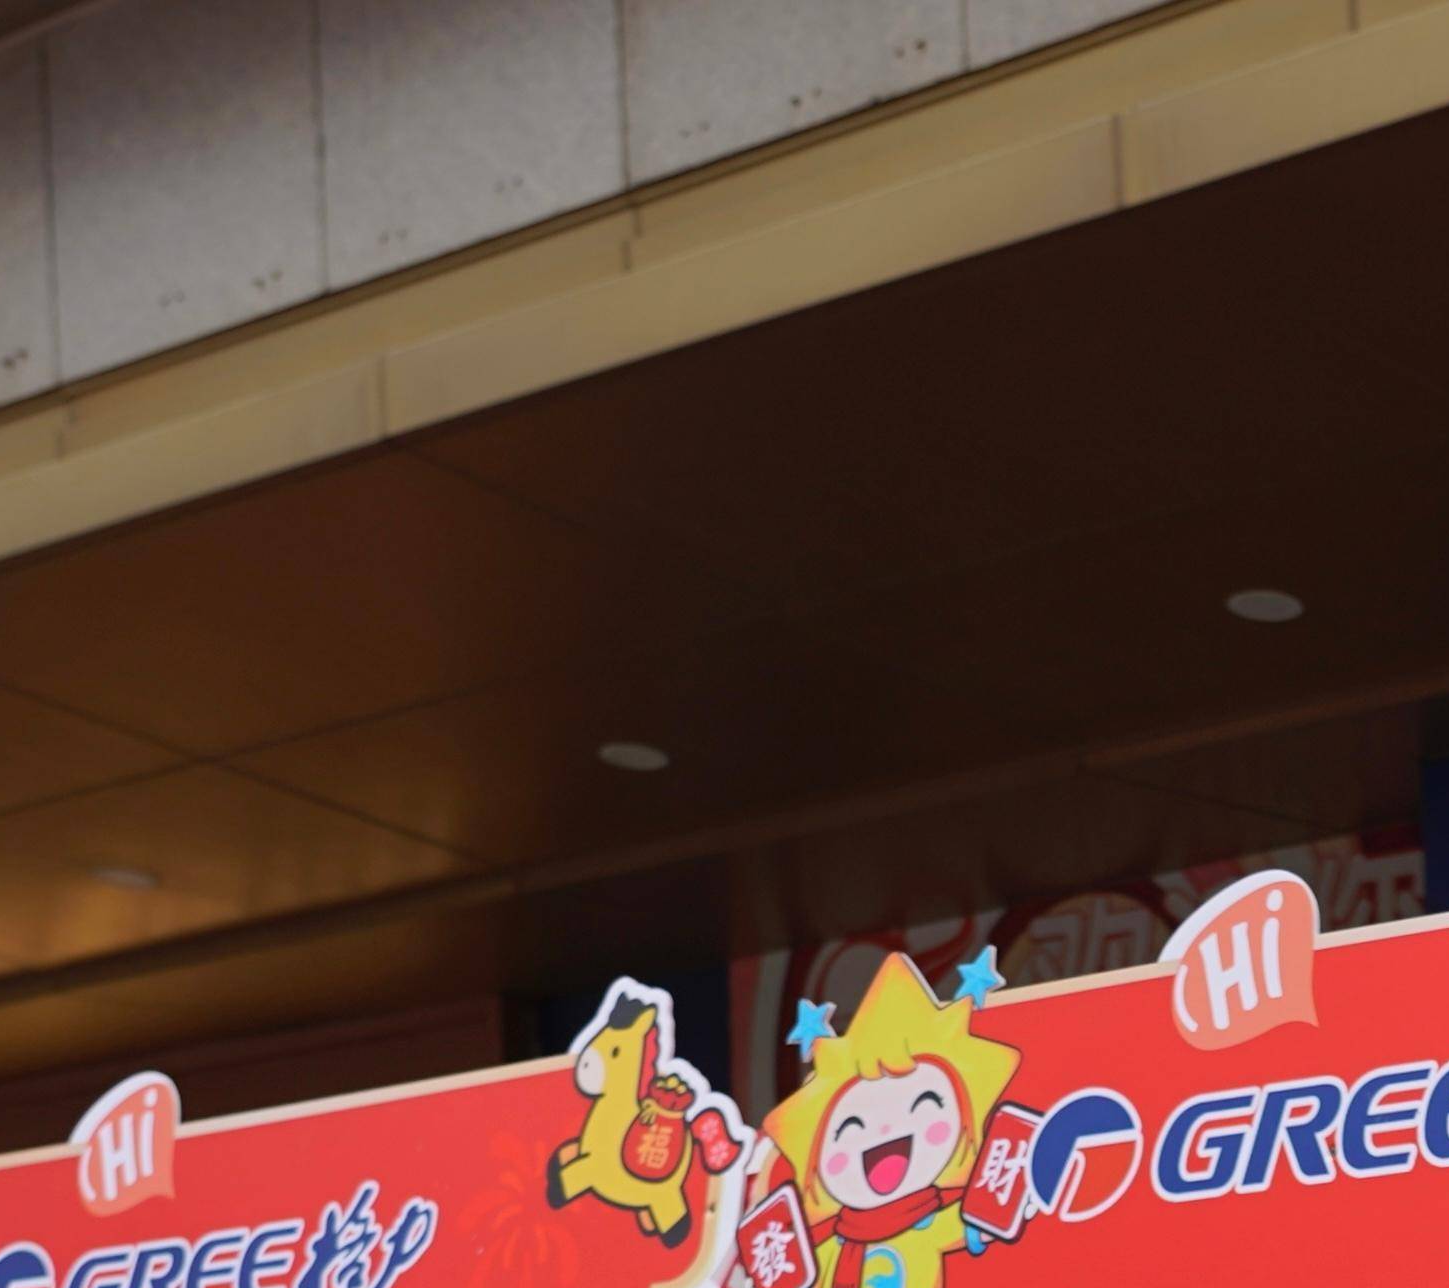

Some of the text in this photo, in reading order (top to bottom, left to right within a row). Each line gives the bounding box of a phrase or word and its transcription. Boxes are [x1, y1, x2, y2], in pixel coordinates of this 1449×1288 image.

[1196, 889, 1286, 1030] Hi
[100, 1090, 159, 1202] Hi
[636, 1126, 669, 1170] 福
